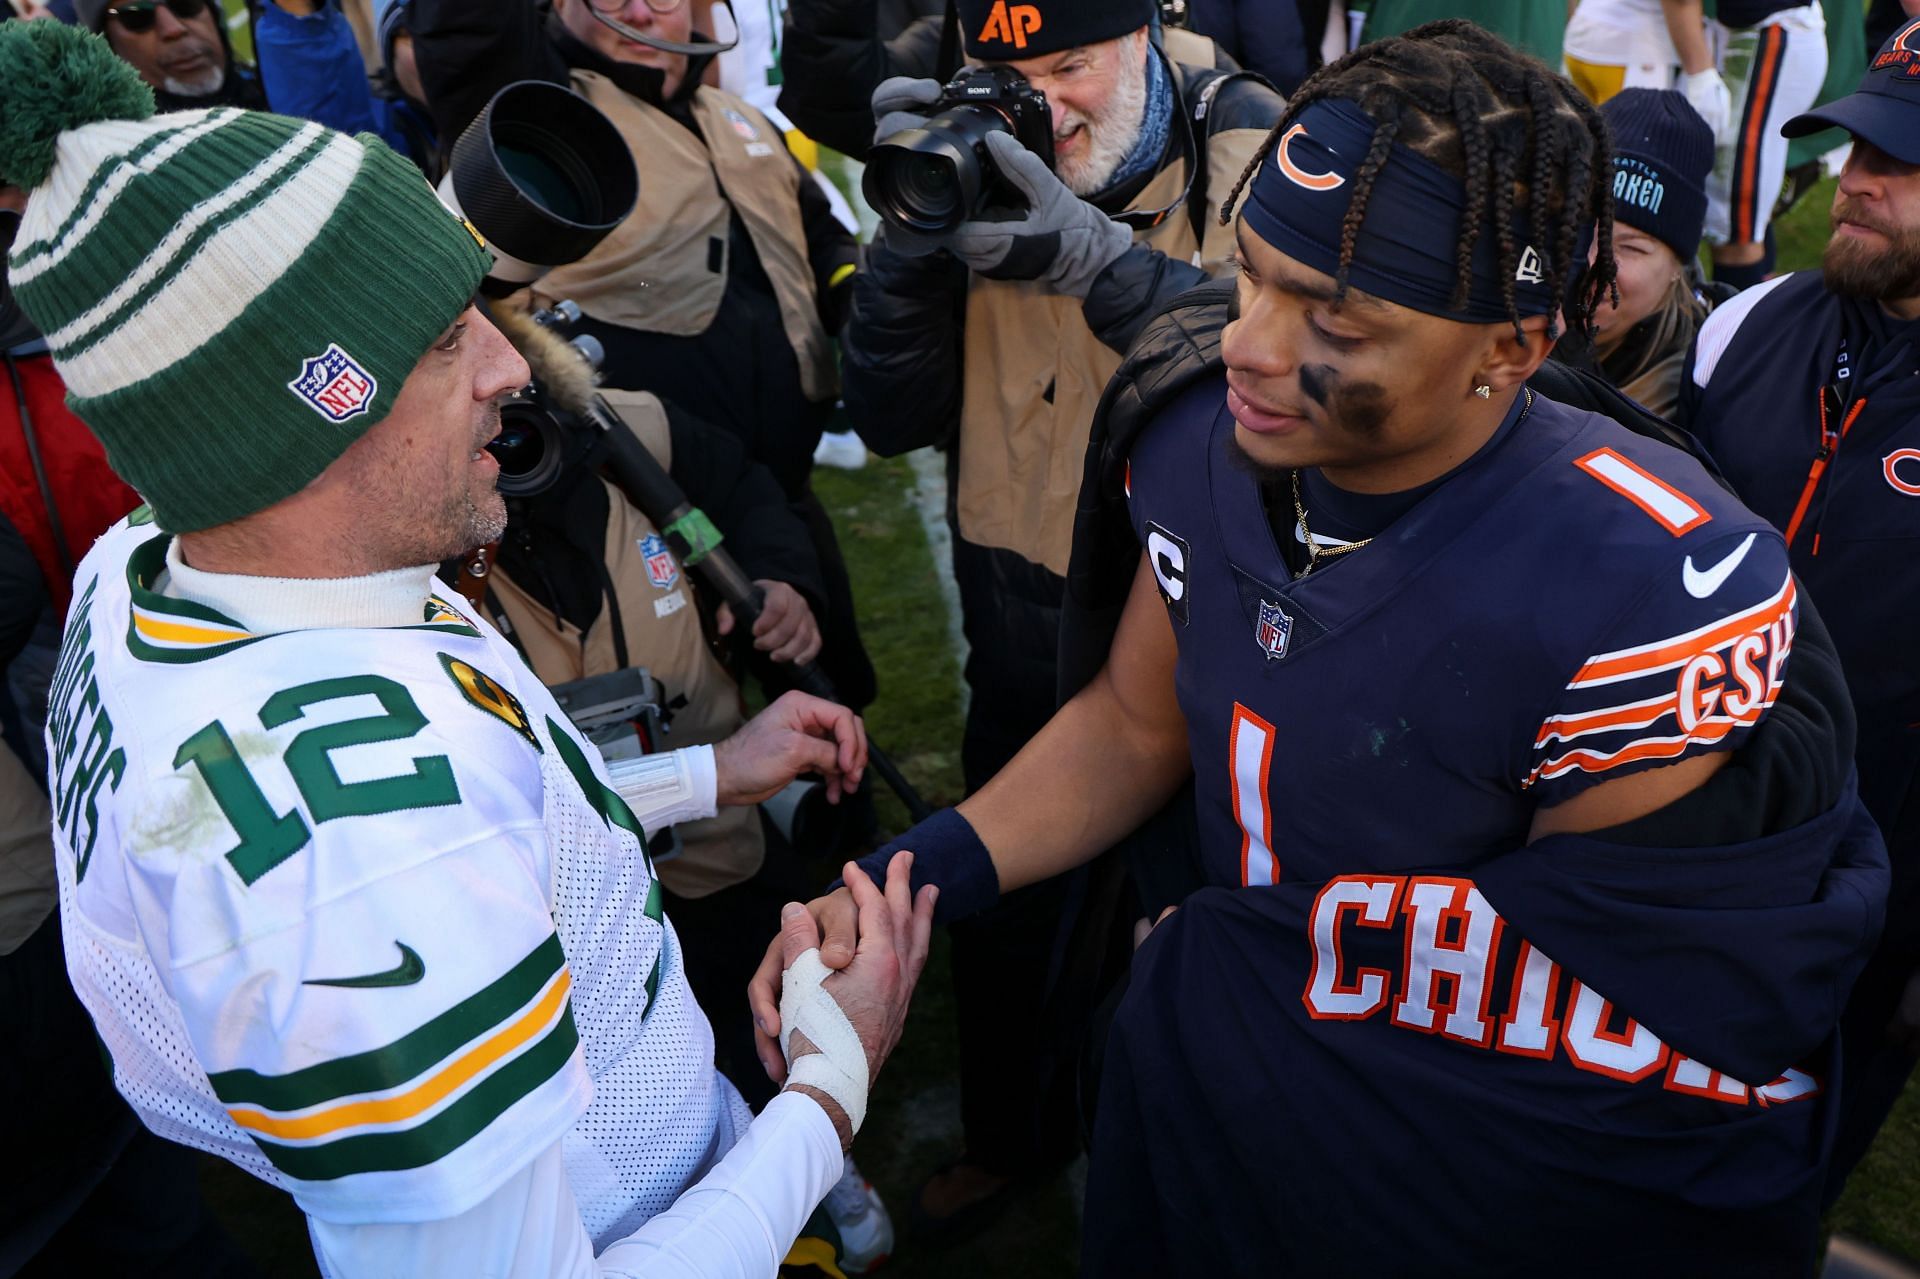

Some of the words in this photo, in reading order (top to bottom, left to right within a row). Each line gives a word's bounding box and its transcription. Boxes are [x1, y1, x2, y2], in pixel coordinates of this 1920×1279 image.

[978, 0, 1041, 49] AP
[1875, 51, 1912, 67] BEARS
[967, 87, 991, 95] SONY
[1612, 157, 1659, 180] EATTLE
[1613, 170, 1664, 214] AKEN
[318, 372, 368, 416] NFL
[1572, 447, 1713, 537] 1
[648, 554, 676, 580] NFL
[1148, 532, 1184, 600] C
[1261, 623, 1282, 651] NFL
[1676, 610, 1795, 734] GSH
[172, 674, 462, 887] 12
[1229, 702, 1280, 887] 1
